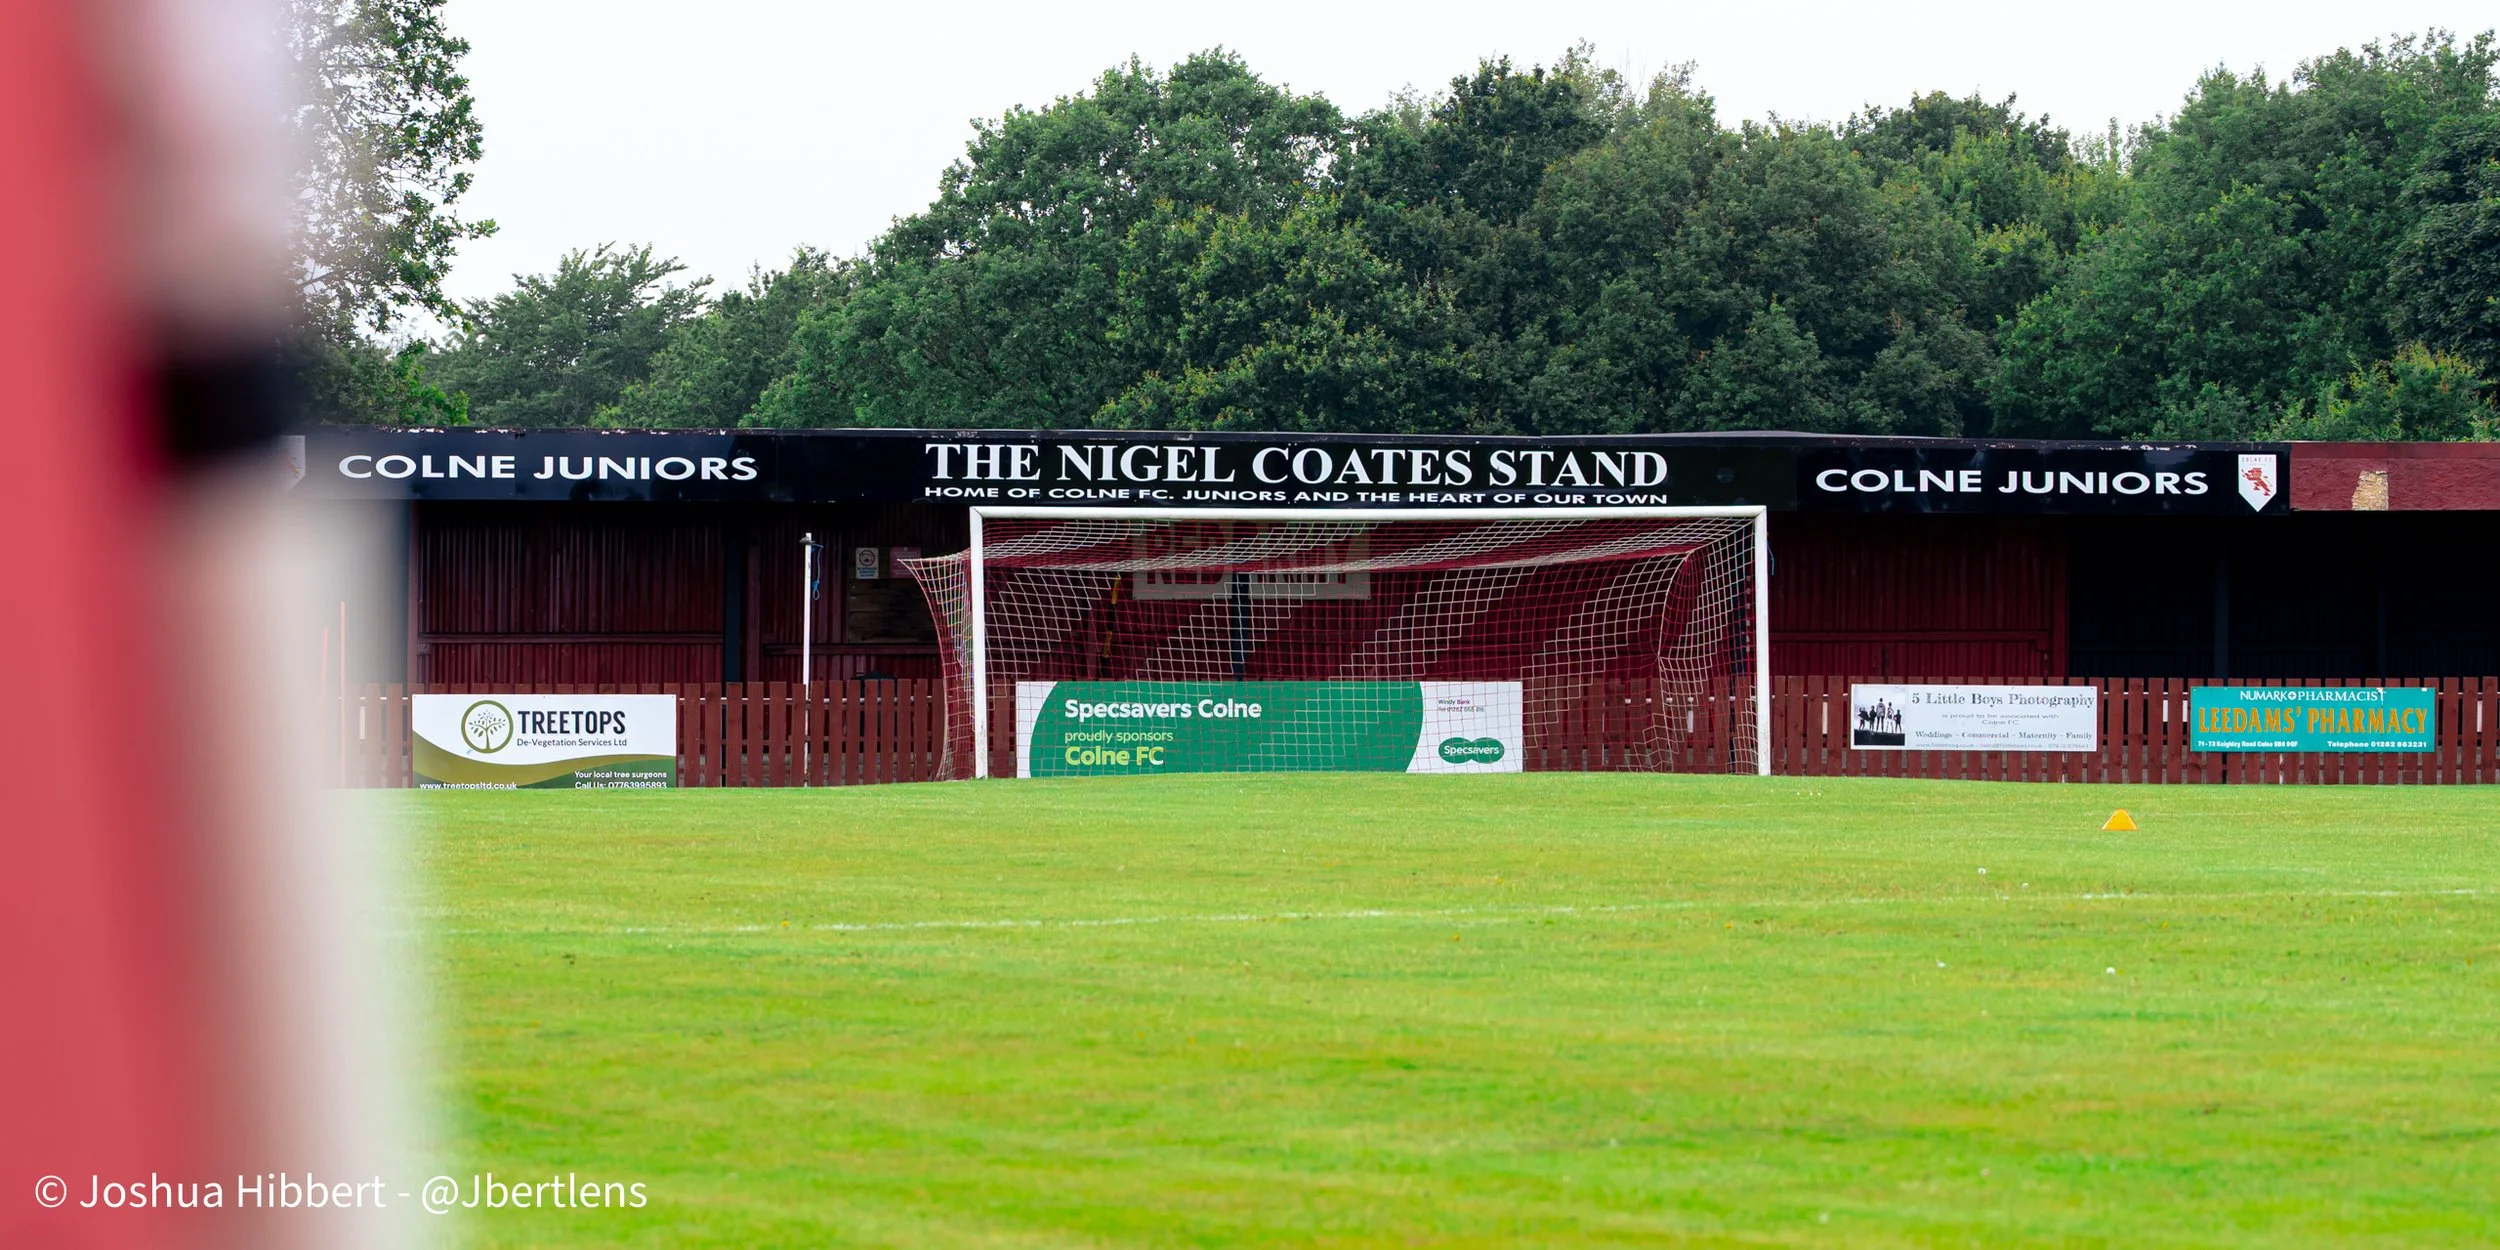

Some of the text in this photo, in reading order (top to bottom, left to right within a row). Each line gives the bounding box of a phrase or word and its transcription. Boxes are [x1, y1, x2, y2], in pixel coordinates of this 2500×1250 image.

[338, 454, 758, 482] COLNE JUNIORS
[925, 443, 1669, 488] THE NIGEL COATES STAND
[1814, 468, 2210, 496] COLNE JUNIORS
[924, 486, 1668, 505] HOME OF COLNE FC. JUNIORS AND THE HEART OF OUR TOWN
[1911, 692, 2095, 708] 5 Little Boys Photography
[2239, 690, 2387, 702] NUMARK PHARMACIST
[1064, 698, 1262, 723] Specsavers Colne
[517, 710, 627, 735] TREETOPS
[2198, 706, 2428, 734] LEEDAMS' PHARMACY
[516, 737, 628, 748] De-Vegetation Services Ltd
[1064, 729, 1174, 744] proudly sponsors
[1915, 730, 1953, 740] Weddings
[1961, 730, 2009, 739] Commercial
[2018, 731, 2058, 740] Maternity
[2065, 731, 2093, 741] Family
[1443, 745, 1500, 757] Specsavers
[2327, 740, 2369, 748] Telephone
[1065, 746, 1165, 766] Colne FC
[574, 770, 668, 780] Your local tree surgeons
[574, 781, 592, 789] Call
